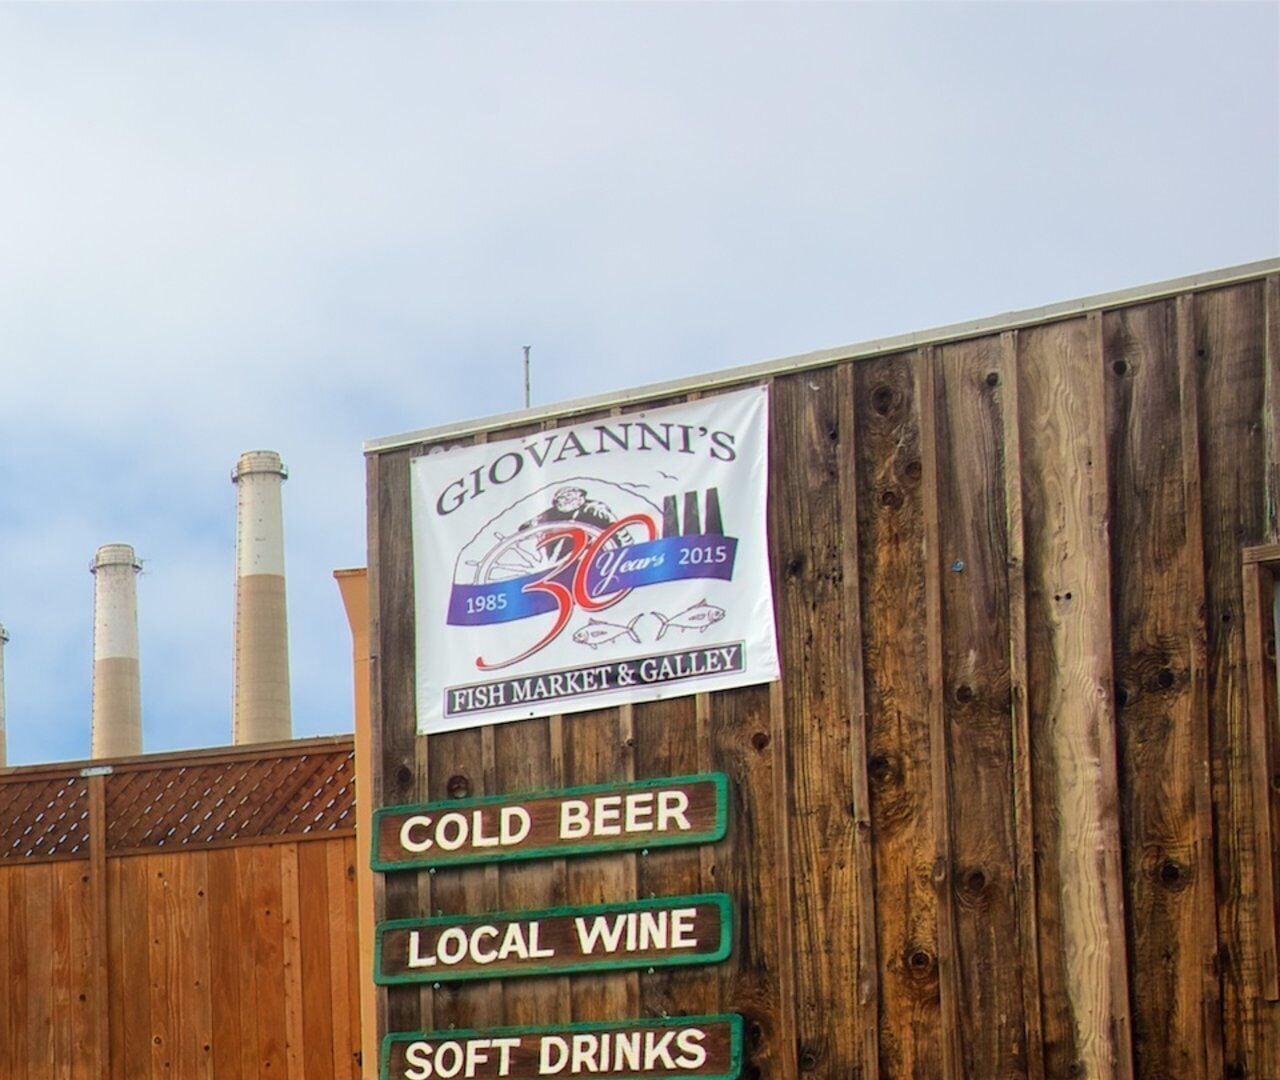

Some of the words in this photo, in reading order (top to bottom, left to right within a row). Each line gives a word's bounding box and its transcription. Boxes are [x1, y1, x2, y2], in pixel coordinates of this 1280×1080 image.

[436, 423, 736, 515] GIOVANNI'S
[679, 547, 726, 565] 2015
[466, 594, 507, 613] 1985
[476, 514, 657, 670] 30
[592, 549, 664, 596] Years
[453, 685, 505, 711] FISH
[512, 668, 611, 701] MARKET
[617, 665, 635, 683] &
[640, 648, 737, 679] GALLEY
[400, 806, 530, 852] COLD
[560, 790, 690, 839] BEER
[408, 921, 554, 968] LOCAL
[575, 908, 697, 954] WINE
[405, 1039, 520, 1080] SOFT
[540, 1028, 707, 1074] DRINKS
